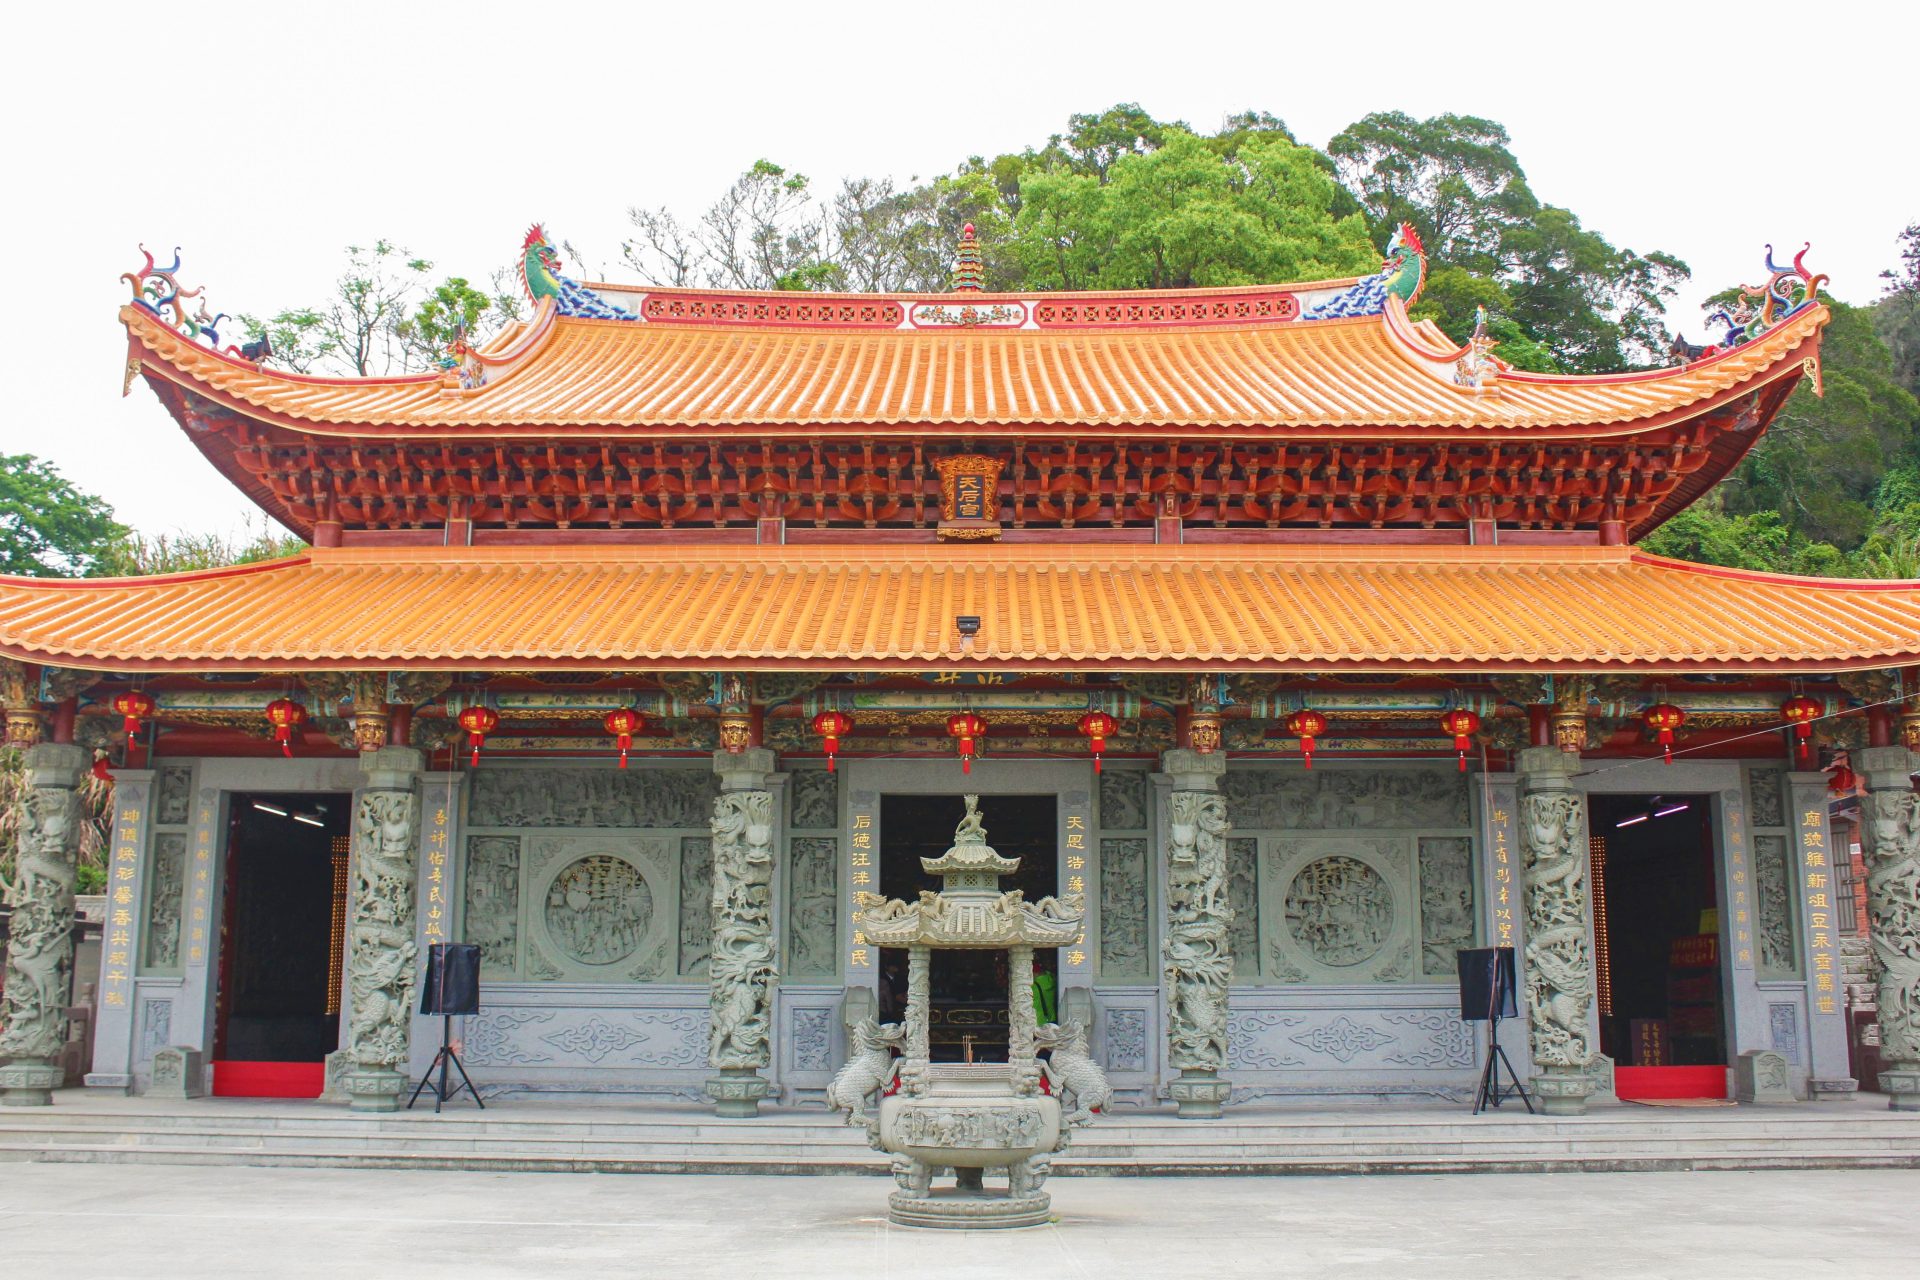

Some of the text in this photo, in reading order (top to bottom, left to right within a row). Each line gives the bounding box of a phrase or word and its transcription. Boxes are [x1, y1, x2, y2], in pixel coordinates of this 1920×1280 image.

[959, 477, 982, 516] 天后宮
[1066, 815, 1086, 966] 天恩浩蕩海
